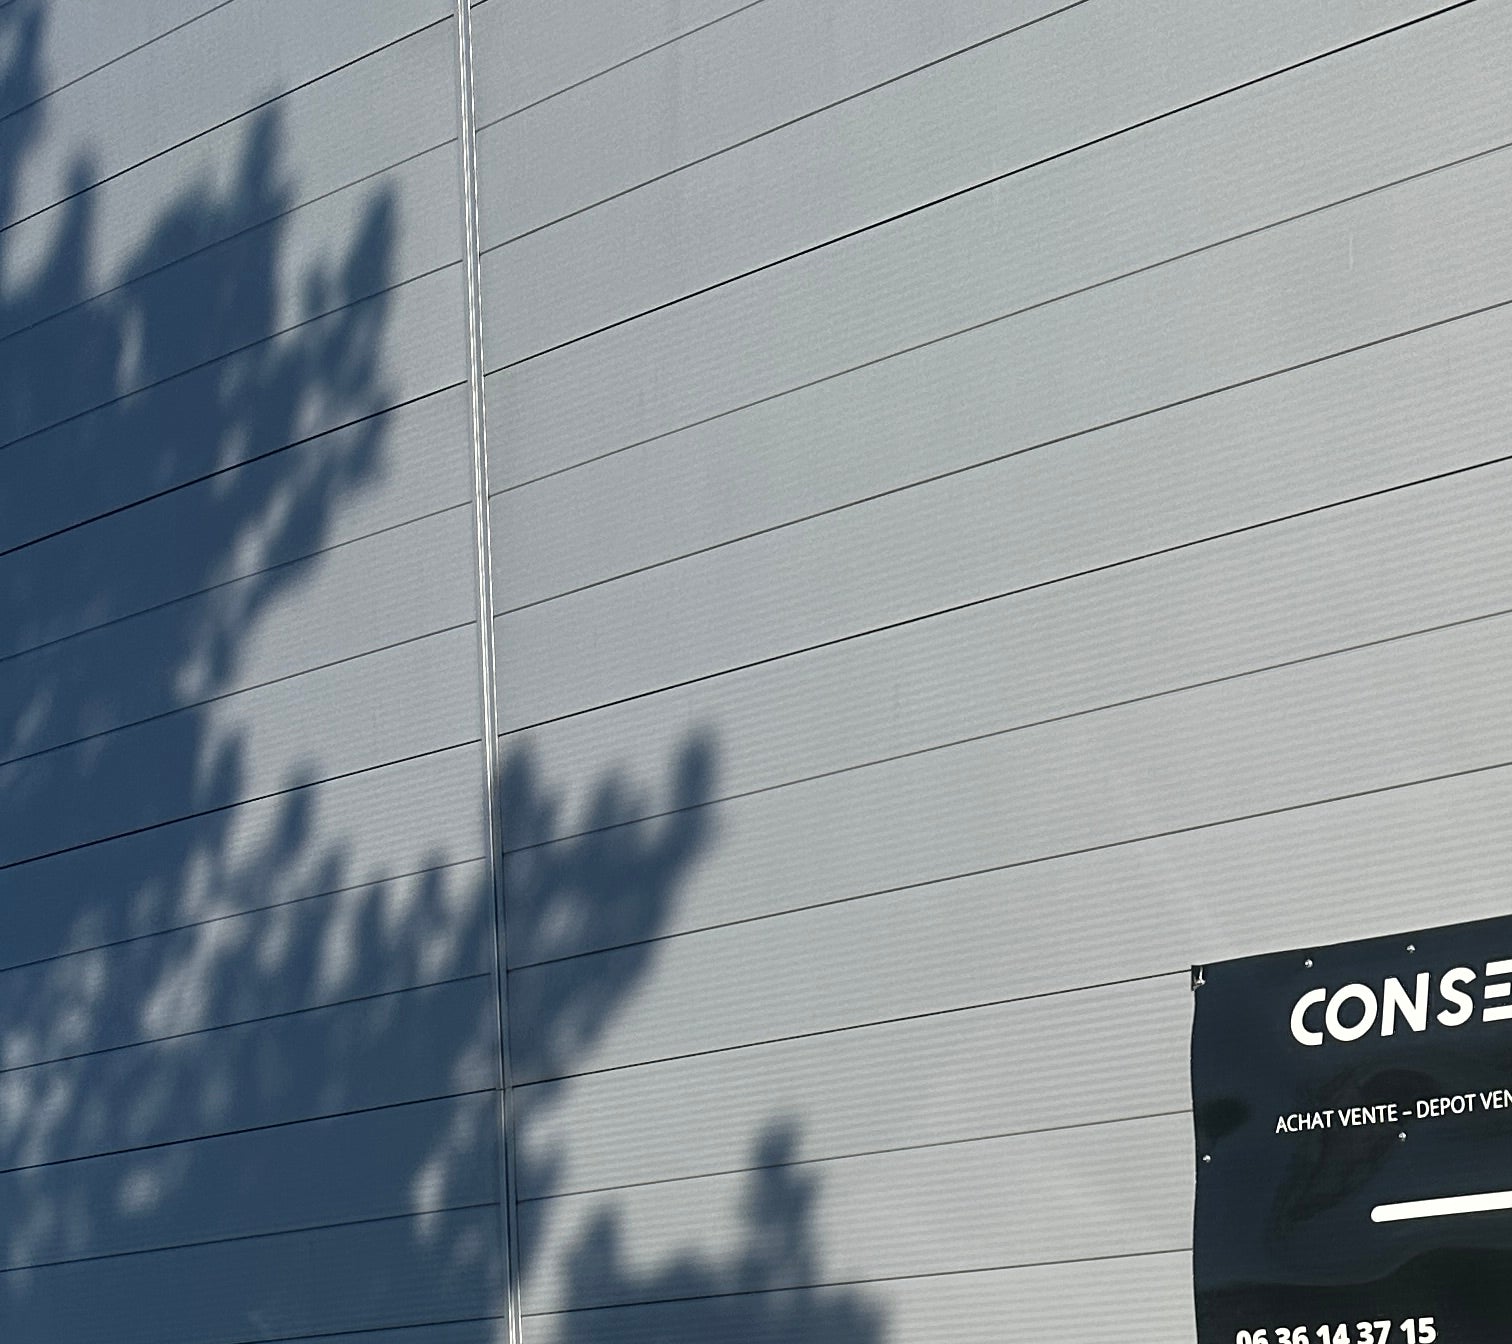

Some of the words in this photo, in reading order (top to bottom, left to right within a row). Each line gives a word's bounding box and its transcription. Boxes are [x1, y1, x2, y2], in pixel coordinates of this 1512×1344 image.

[1275, 1109, 1335, 1134] ACHAT
[1337, 1103, 1399, 1127] VENTE
[1416, 1093, 1477, 1119] DEPOT
[1399, 1316, 1437, 1344] 15
